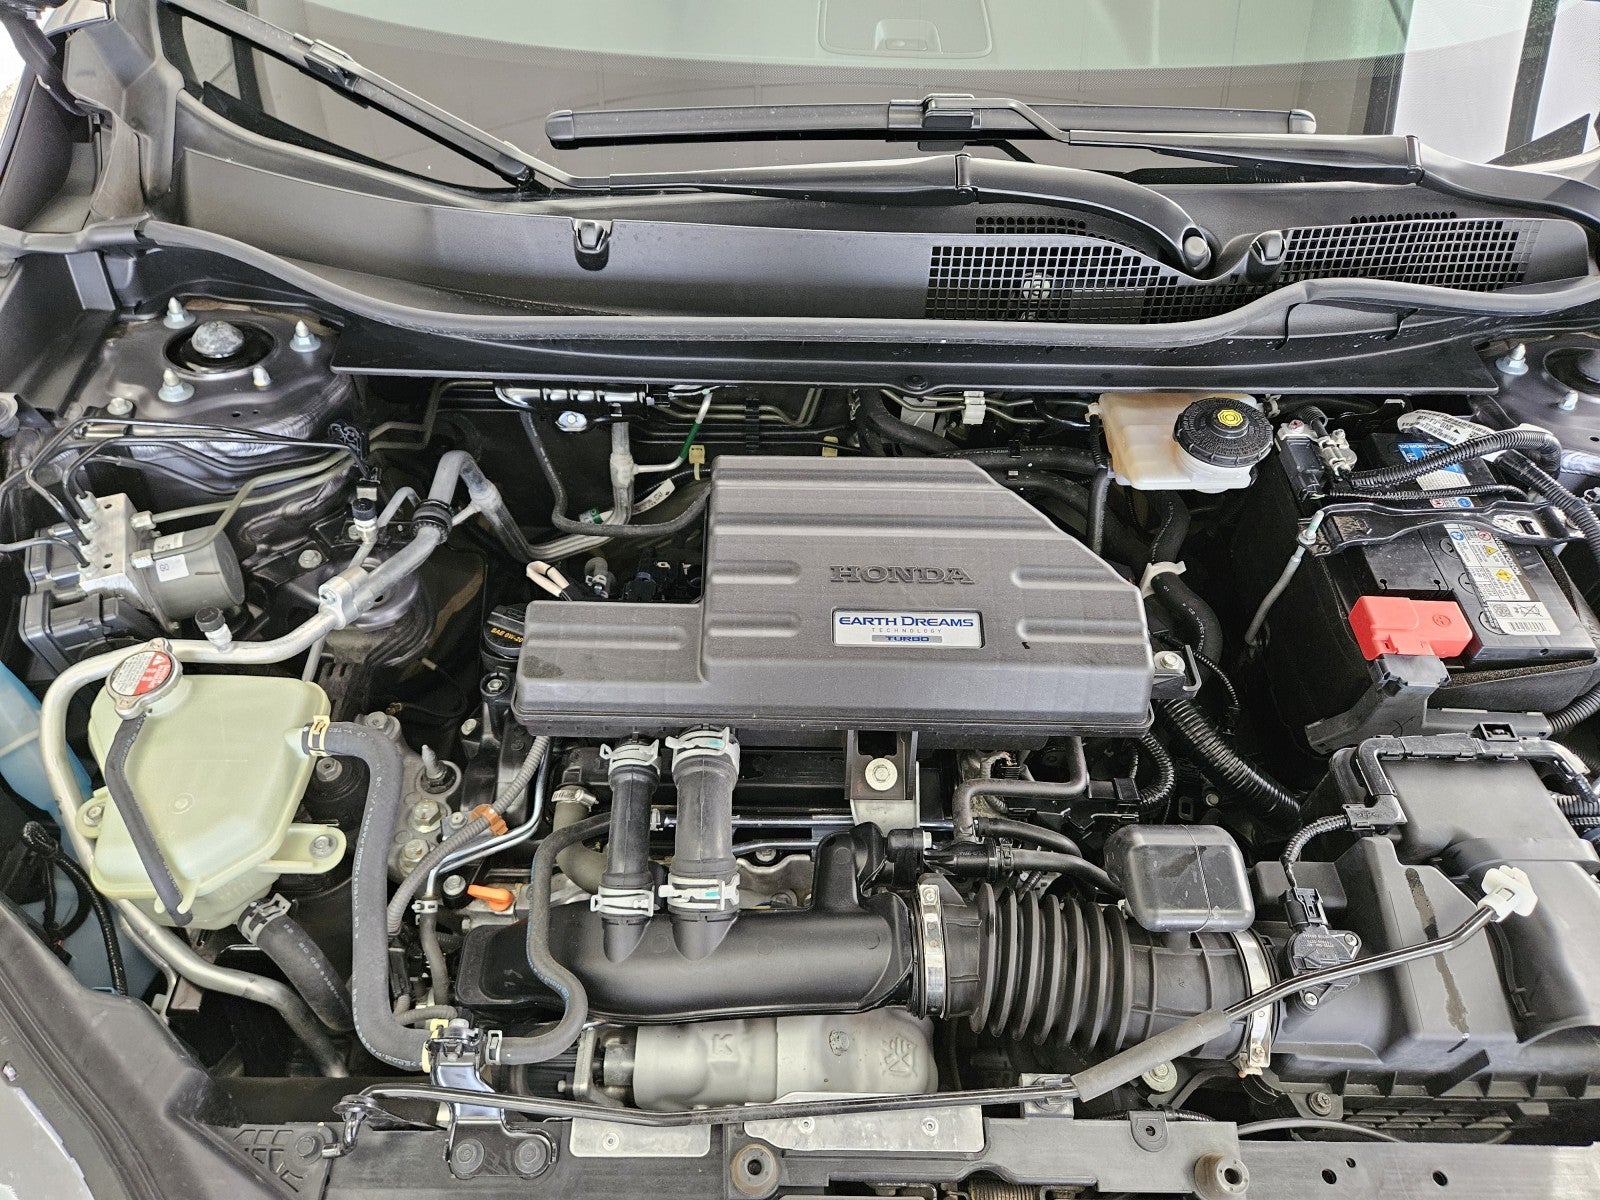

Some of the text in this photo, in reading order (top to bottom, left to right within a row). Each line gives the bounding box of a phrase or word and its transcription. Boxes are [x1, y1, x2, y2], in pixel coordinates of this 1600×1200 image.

[829, 565, 975, 585] HONDA
[838, 616, 974, 627] EARTH DREAMS
